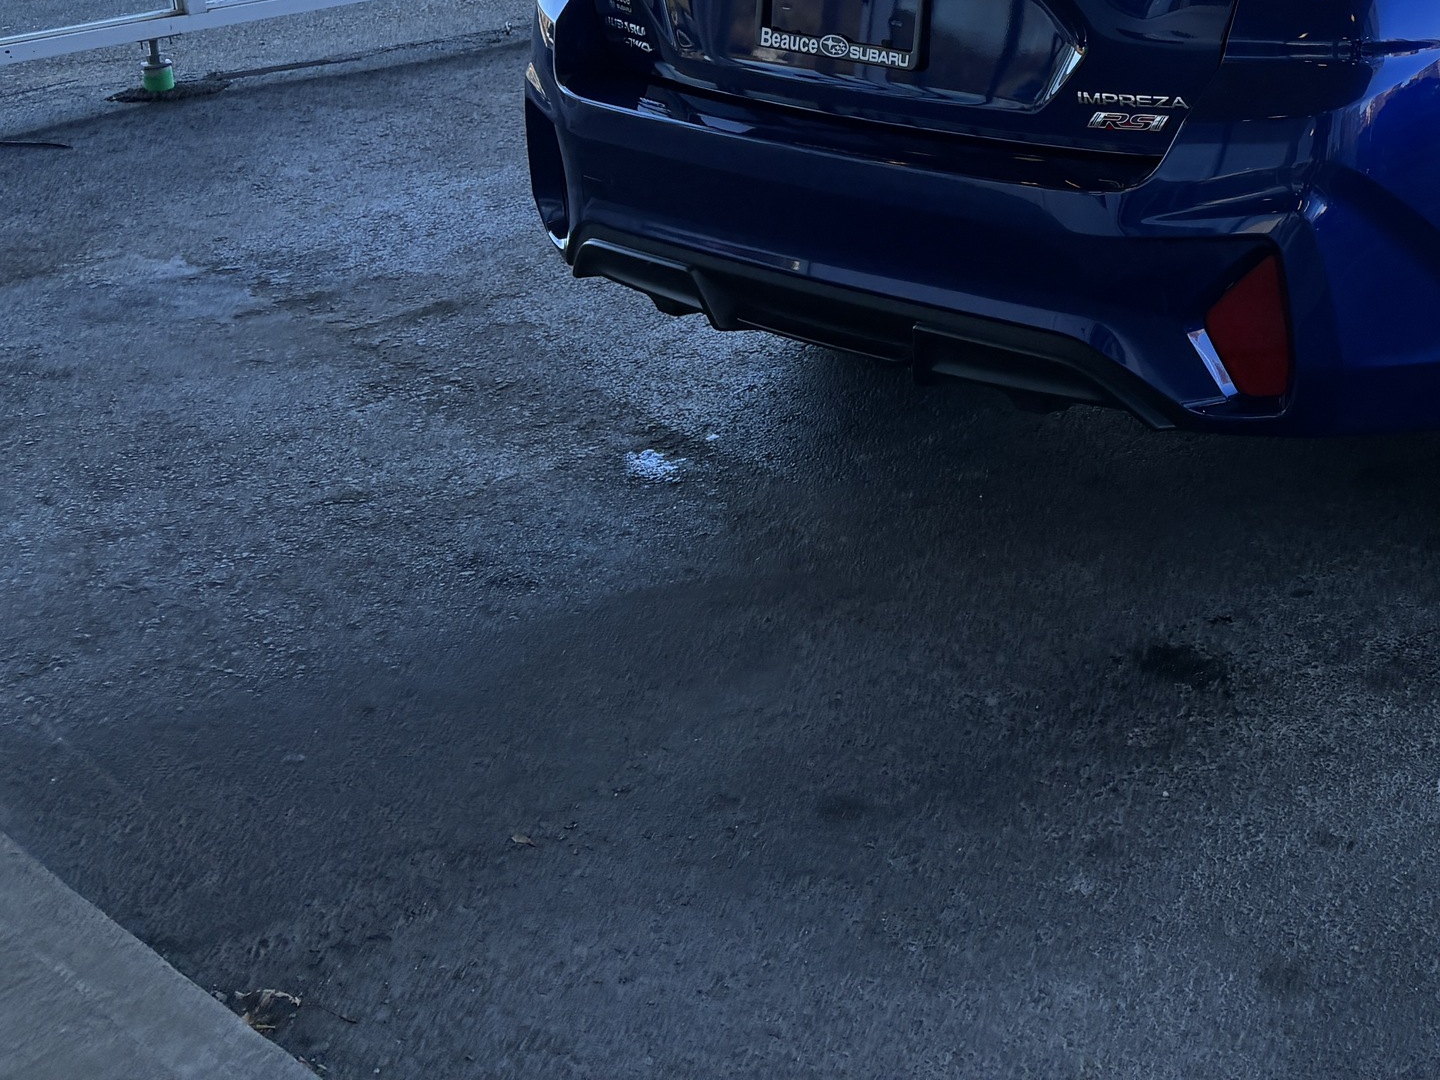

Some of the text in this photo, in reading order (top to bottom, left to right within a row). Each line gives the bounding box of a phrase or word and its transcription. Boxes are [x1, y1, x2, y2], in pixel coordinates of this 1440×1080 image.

[760, 27, 910, 67] Beauce SUBARU
[1077, 91, 1190, 110] IMPREZA
[1094, 111, 1161, 131] RS
